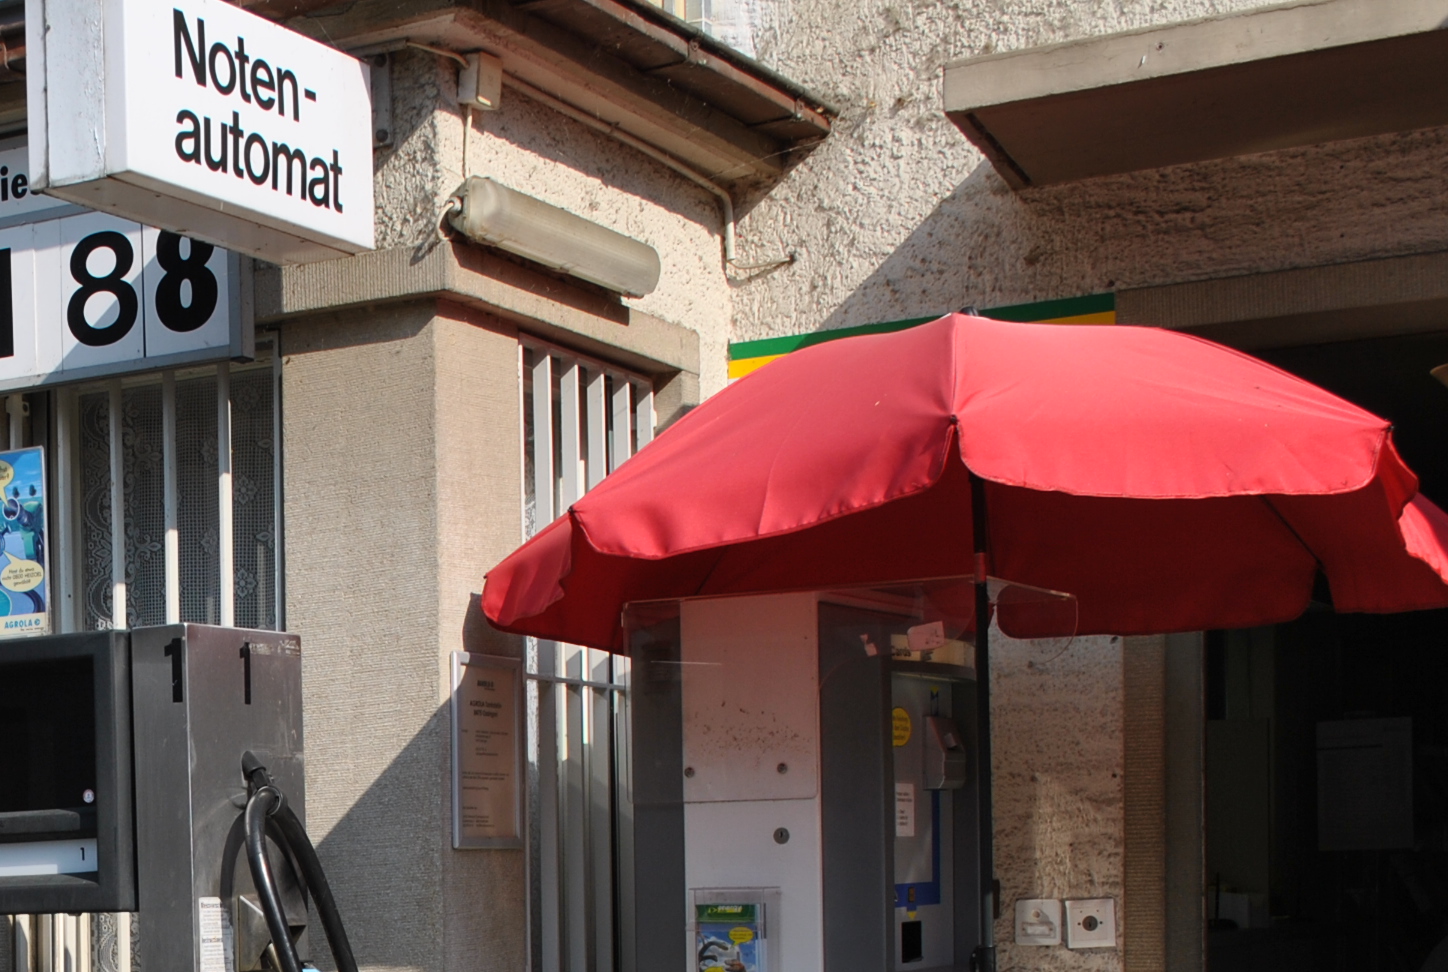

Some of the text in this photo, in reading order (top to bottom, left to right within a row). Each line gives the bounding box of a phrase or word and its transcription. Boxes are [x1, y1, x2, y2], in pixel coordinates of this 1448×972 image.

[172, 8, 317, 122] Noten-
[175, 109, 343, 213] automat
[5, 619, 33, 629] AGROLA
[165, 638, 183, 702] 1
[239, 642, 251, 705] 1
[79, 847, 86, 861] 1
